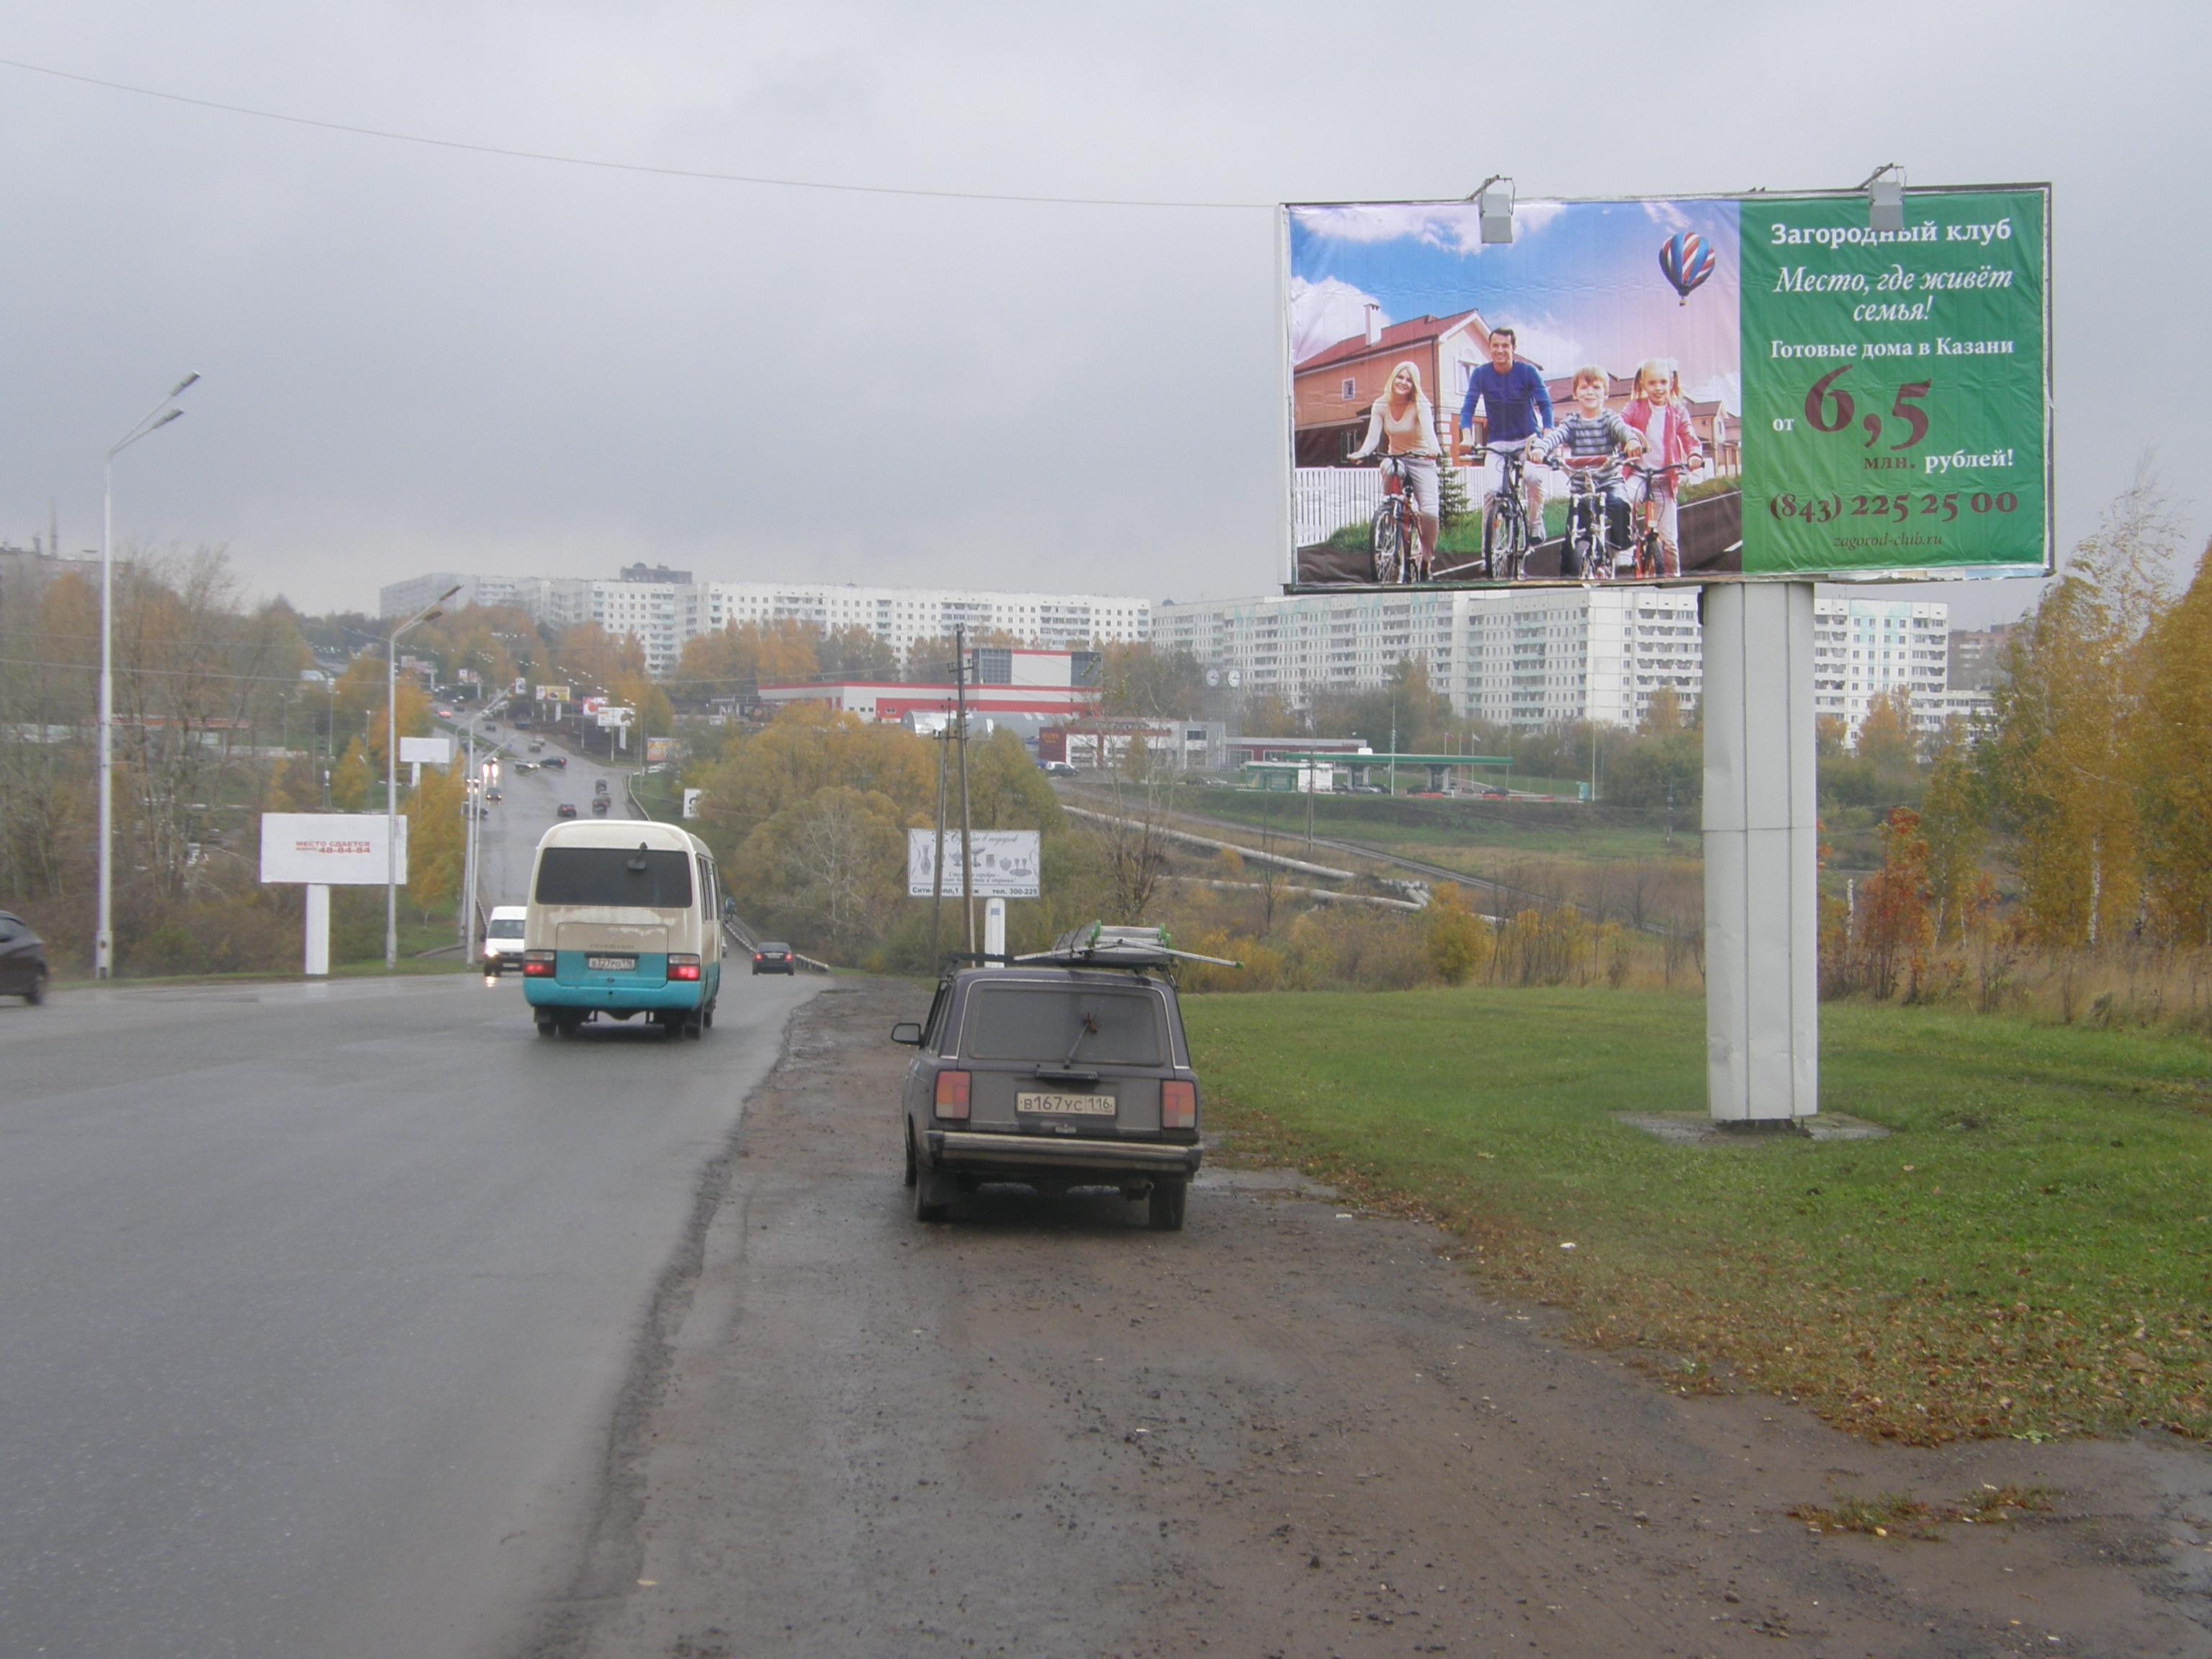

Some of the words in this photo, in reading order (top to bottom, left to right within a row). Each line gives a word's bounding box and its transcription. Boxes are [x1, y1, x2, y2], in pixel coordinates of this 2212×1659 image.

[1771, 220, 1938, 249] Загородный
[1946, 217, 2012, 246] клуб
[1772, 266, 1870, 296] Место,
[1876, 264, 1914, 291] где
[1919, 264, 2013, 289] живёт
[1853, 295, 1934, 322] семья!
[1770, 340, 1858, 359] Готовые
[1861, 341, 1913, 360] дома
[1917, 342, 1930, 355] в
[1936, 337, 2014, 355] Казани
[1773, 418, 1795, 431] от
[1804, 363, 1933, 451] 6,5
[1863, 457, 1916, 470] млн.
[1924, 449, 2014, 474] рублей!
[1769, 491, 1843, 524] (843)
[1851, 492, 1910, 523] 225
[1920, 491, 1960, 523] 25
[1970, 491, 2018, 513] 00
[1833, 532, 1943, 552] zagorod-club.ru
